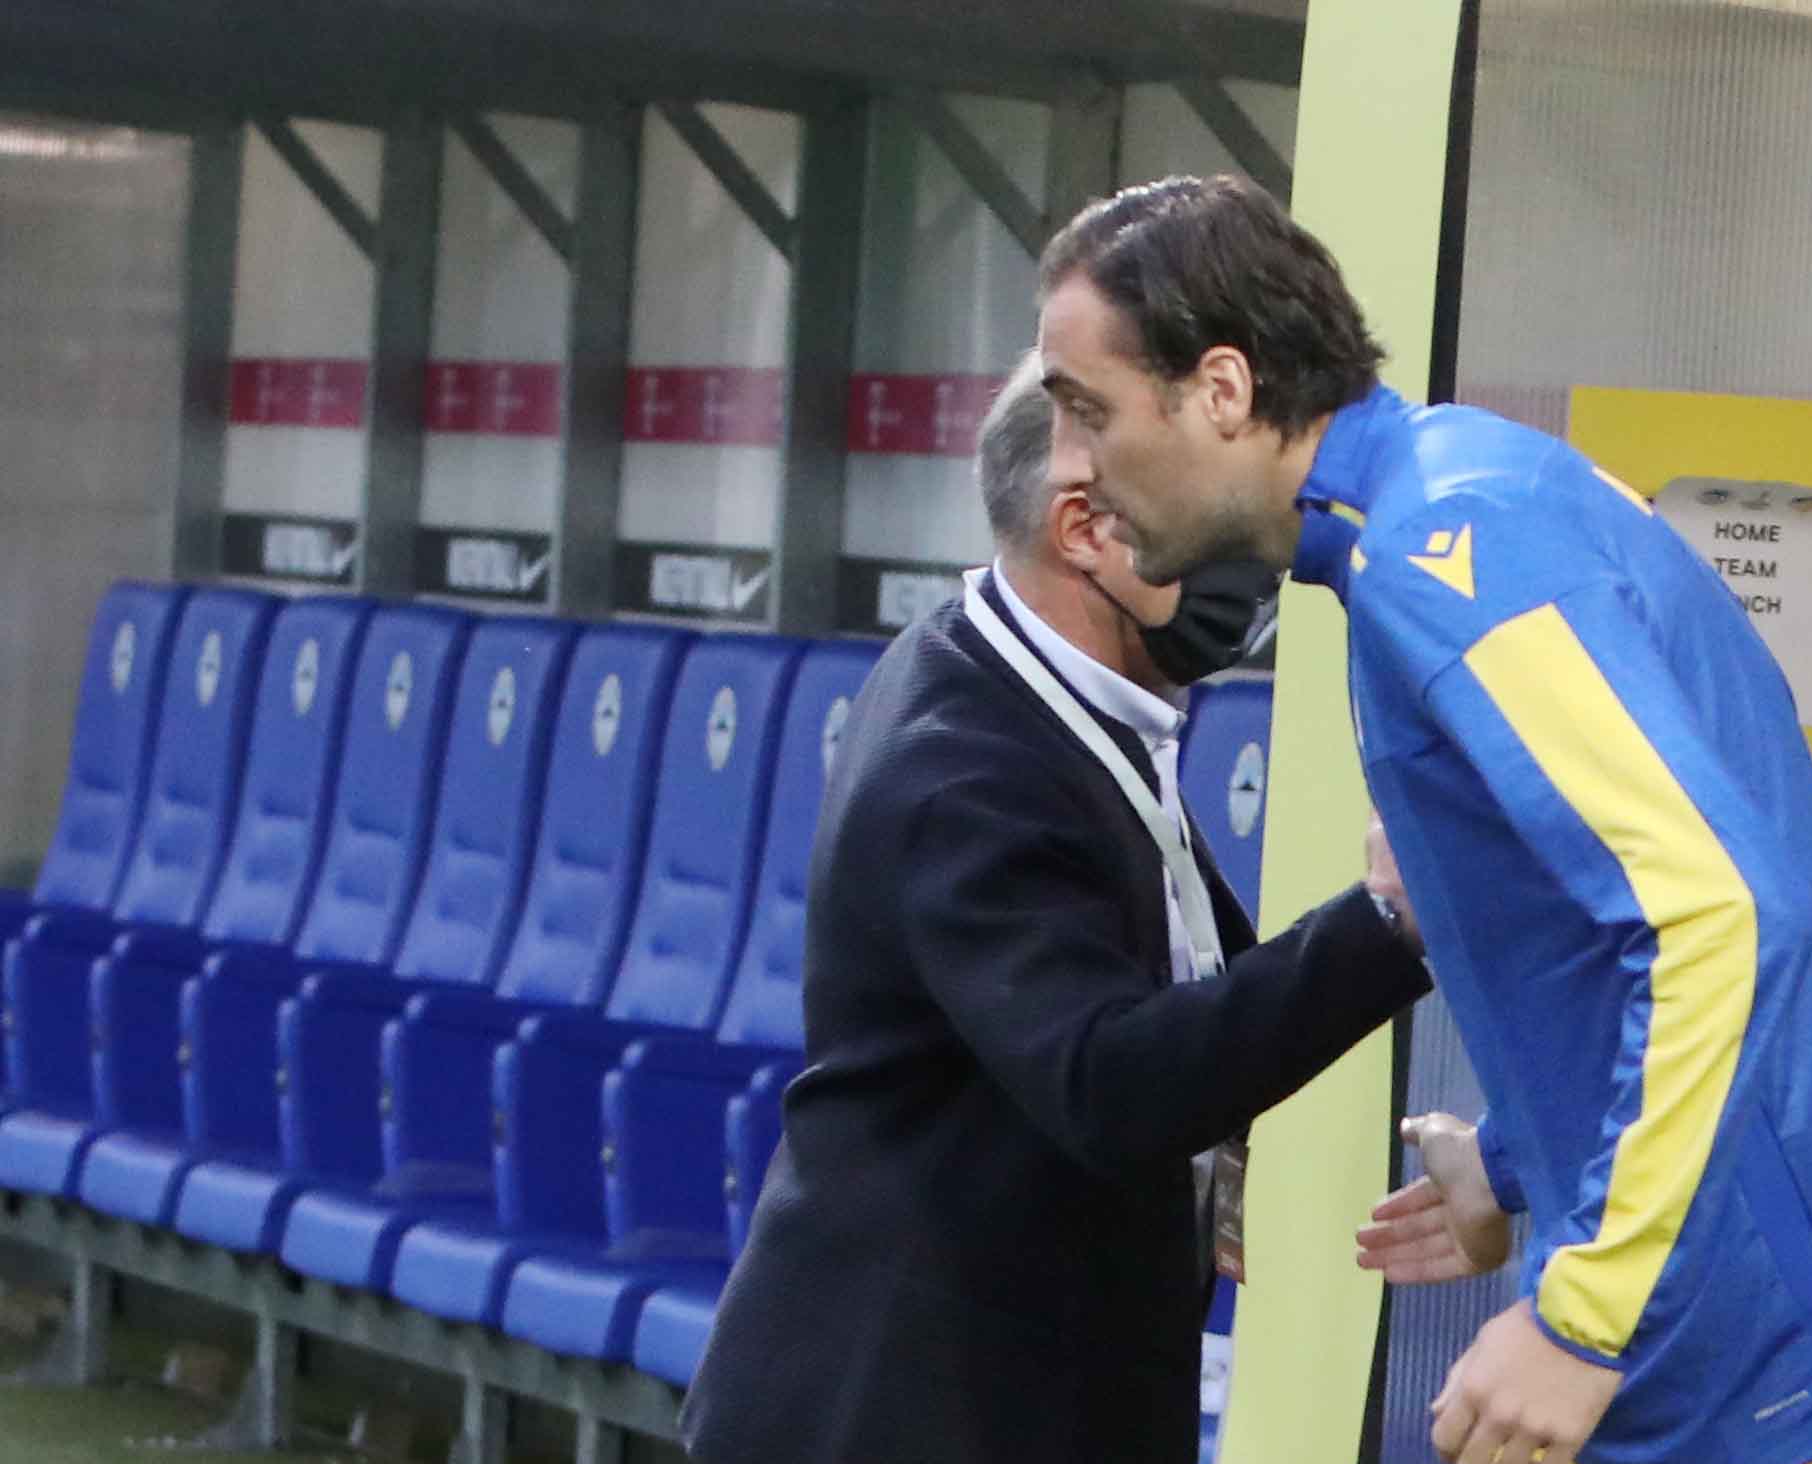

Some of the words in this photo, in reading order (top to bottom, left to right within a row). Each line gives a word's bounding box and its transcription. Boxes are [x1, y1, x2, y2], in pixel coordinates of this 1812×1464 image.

[1714, 521, 1781, 542] HOME
[1714, 558, 1777, 577] TEAM
[1740, 595, 1782, 614] NCH
